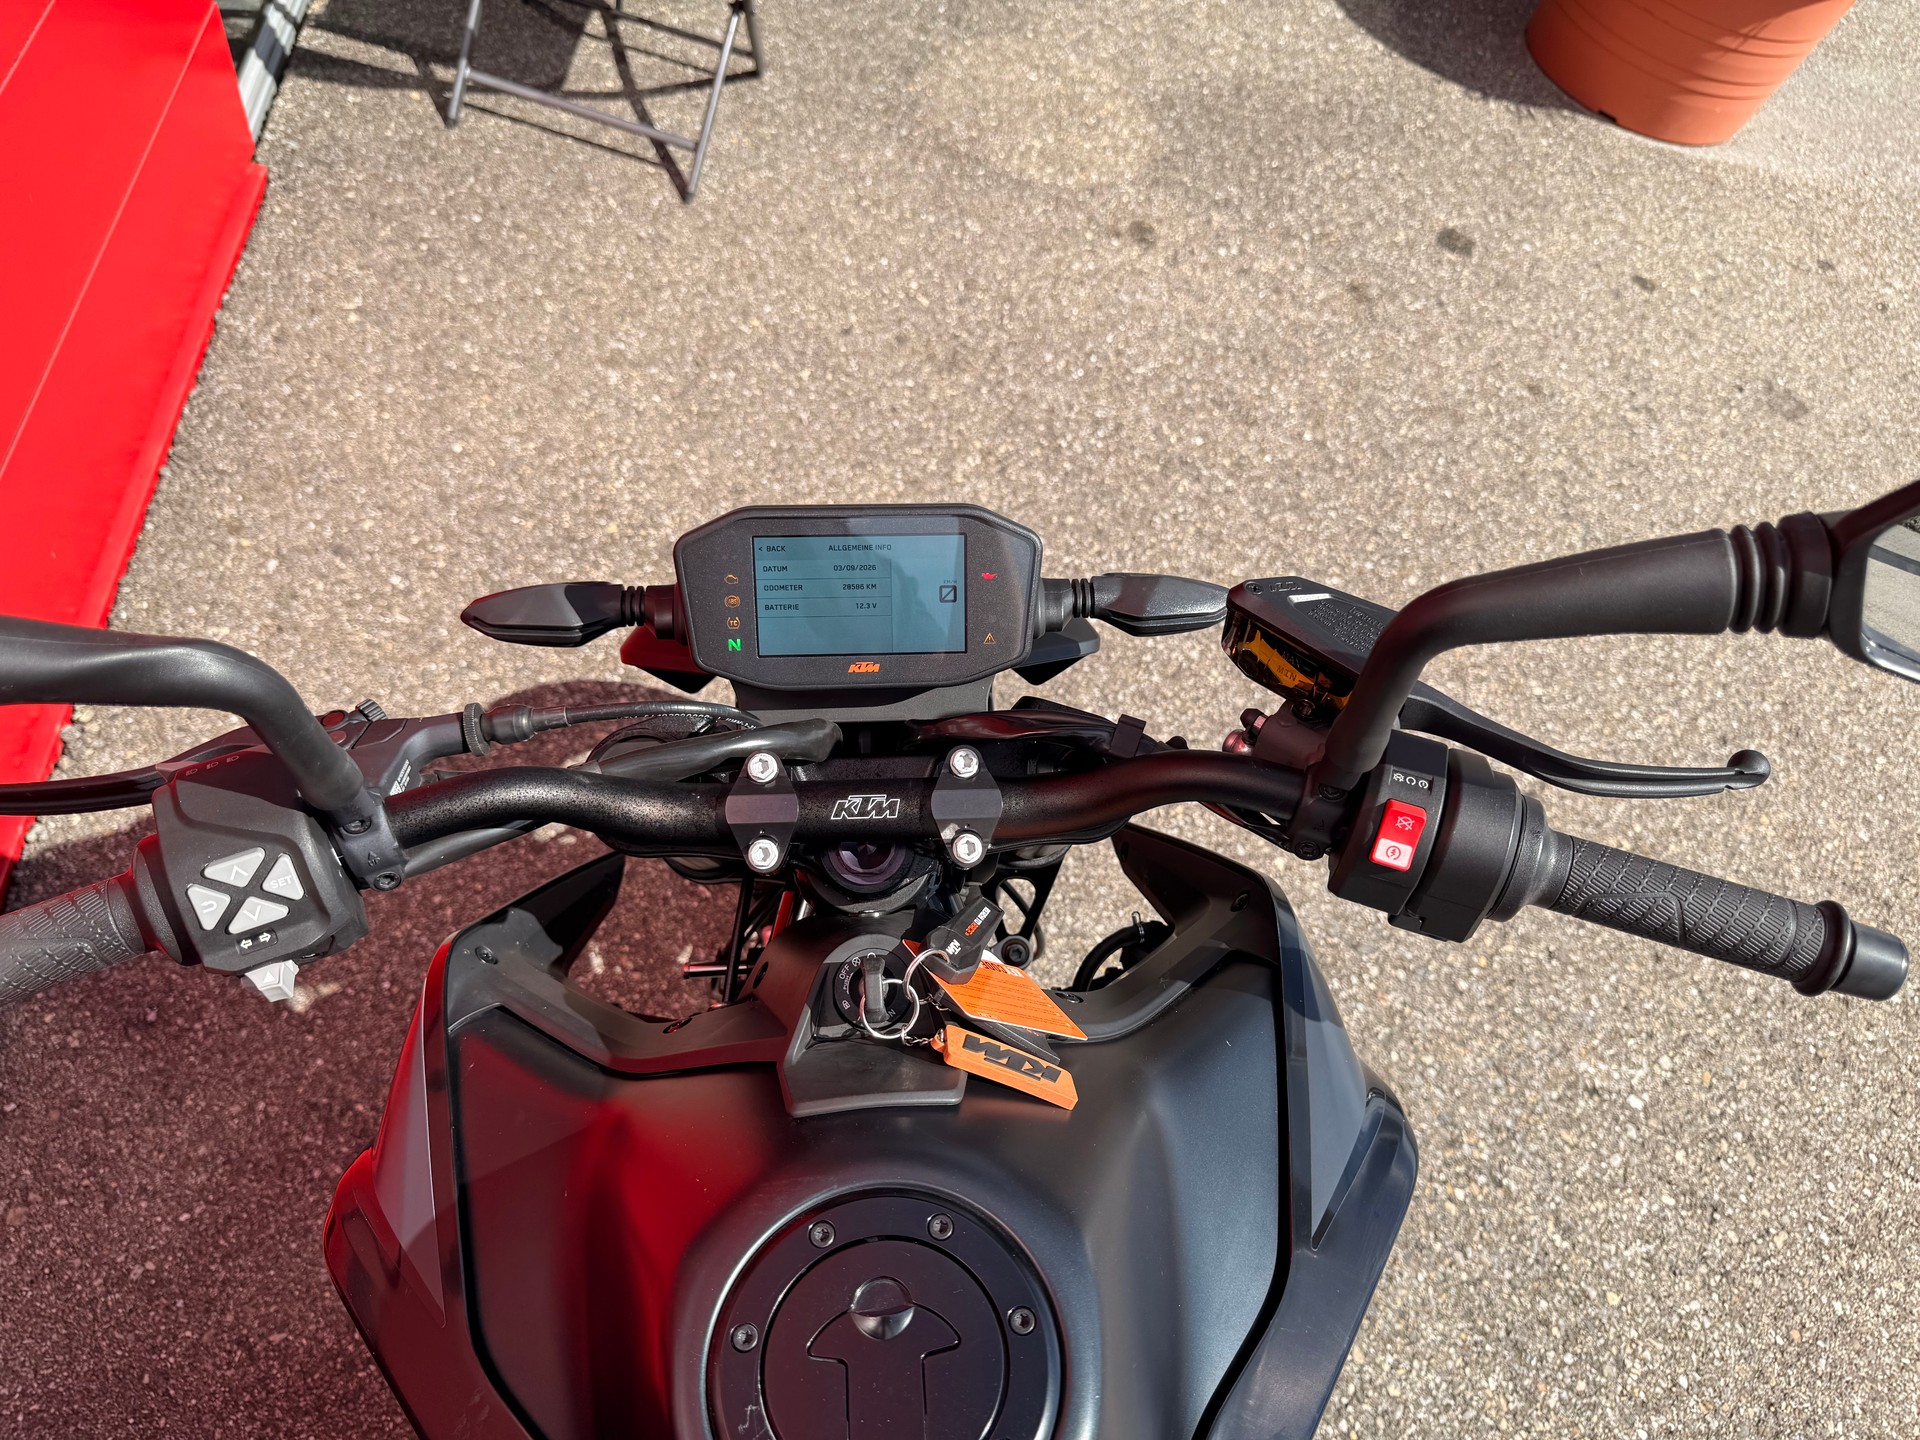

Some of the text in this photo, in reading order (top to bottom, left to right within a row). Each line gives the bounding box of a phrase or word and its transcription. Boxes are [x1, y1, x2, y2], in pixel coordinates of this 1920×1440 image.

[828, 544, 874, 552] ALLGEMEINE
[764, 603, 800, 611] BATTERIE
[728, 638, 742, 652] N
[848, 661, 881, 673] KTM
[1276, 665, 1297, 681] MIN
[831, 794, 900, 820] KTM
[270, 875, 293, 889] SET
[945, 938, 962, 955] KTM
[838, 963, 850, 979] OFF
[962, 1034, 1062, 1083] KTM
